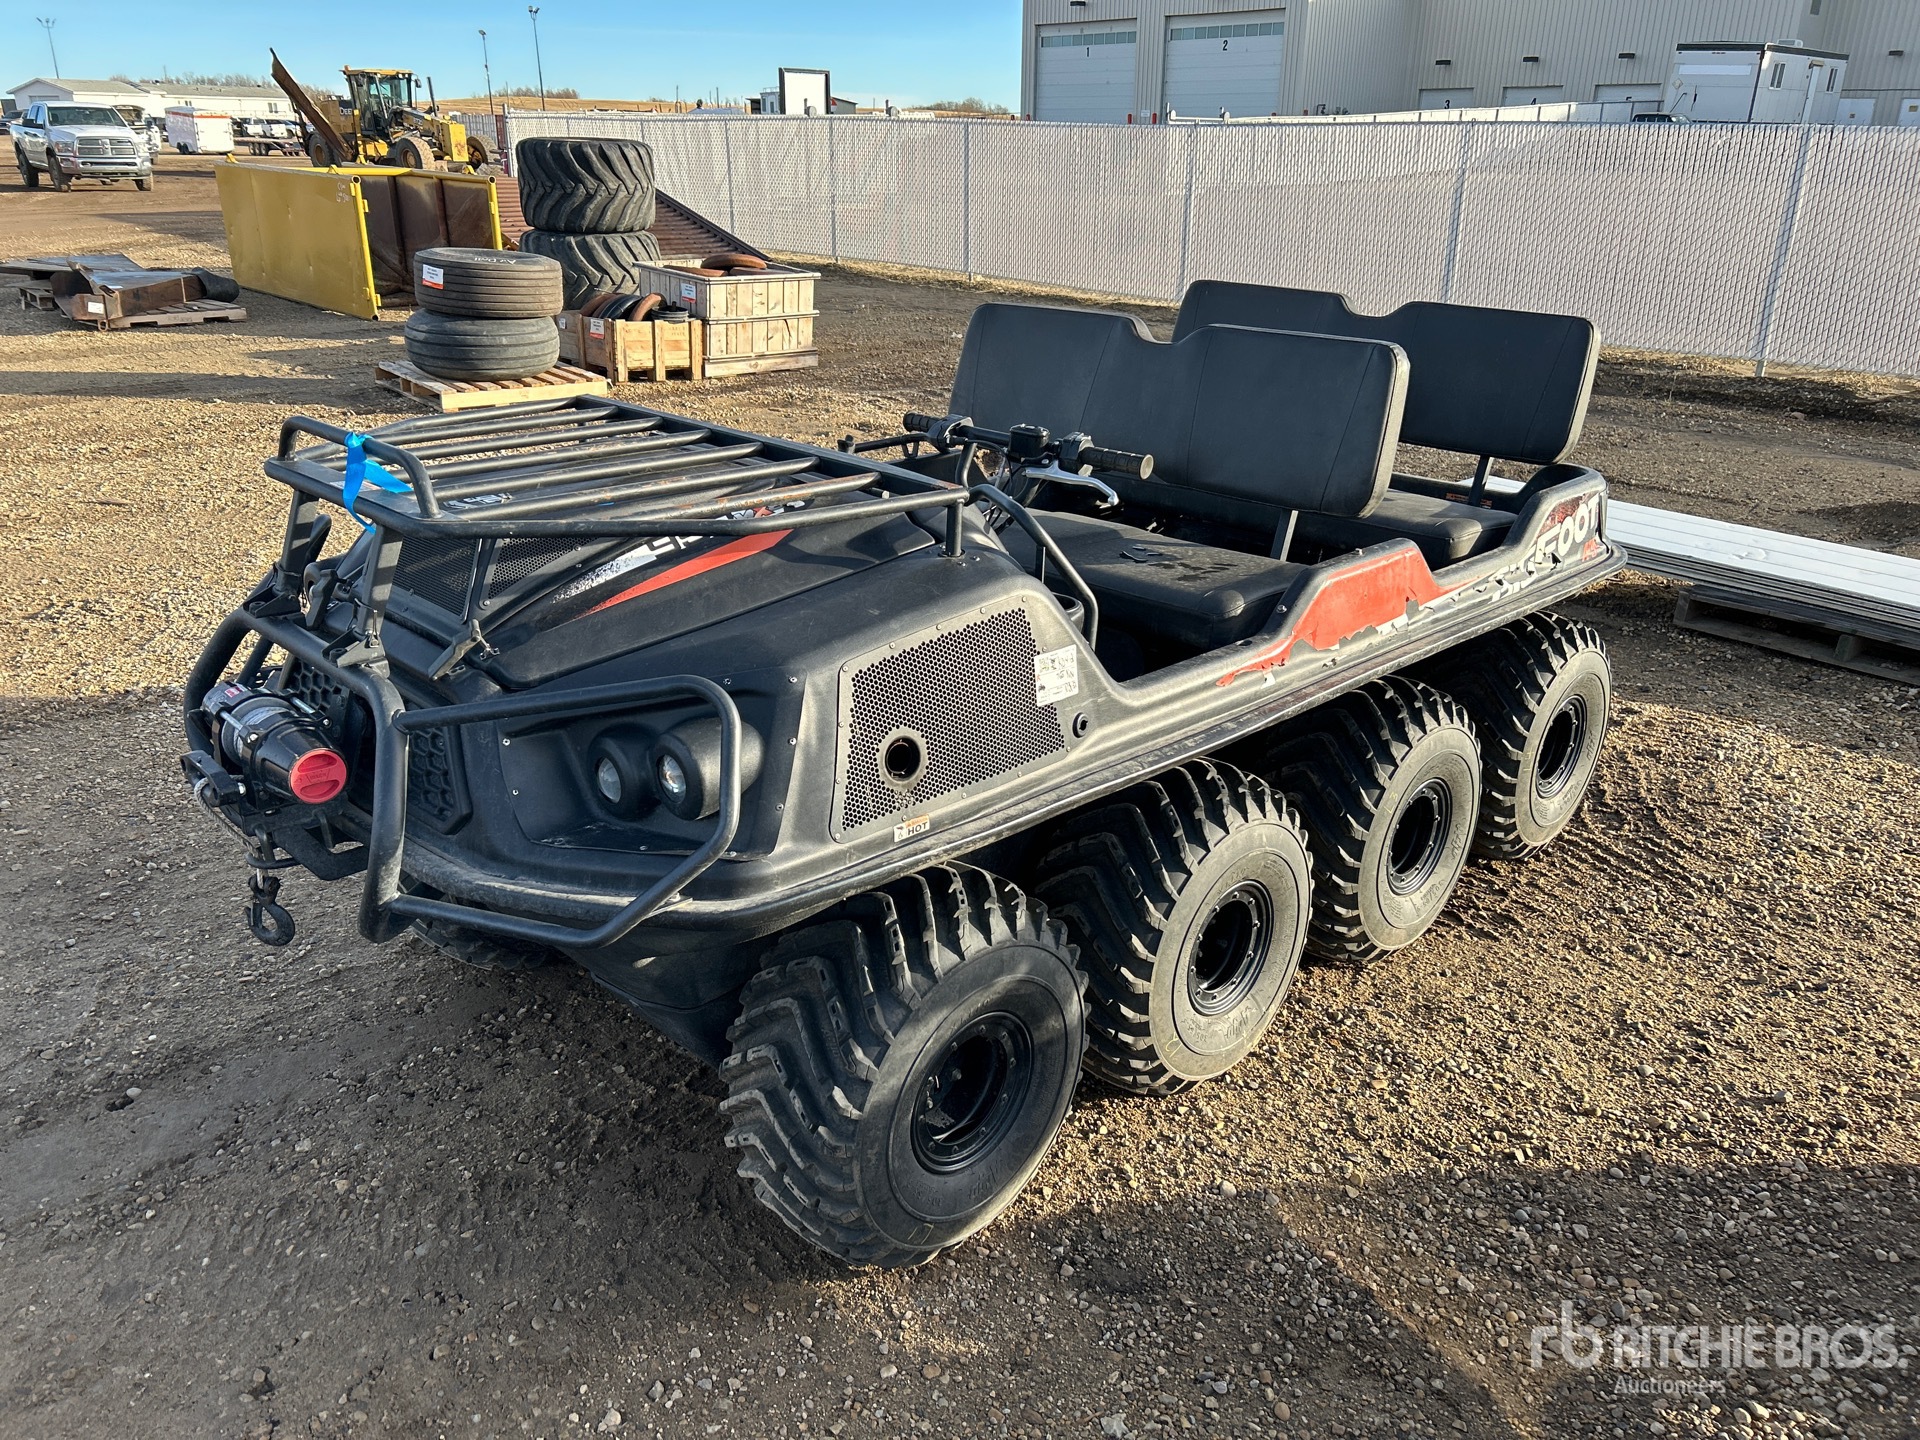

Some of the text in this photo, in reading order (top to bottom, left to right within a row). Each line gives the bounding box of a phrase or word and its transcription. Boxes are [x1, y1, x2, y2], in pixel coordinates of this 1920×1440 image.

[1222, 39, 1229, 51] 2
[1444, 99, 1450, 110] 3
[907, 821, 928, 836] HOT
